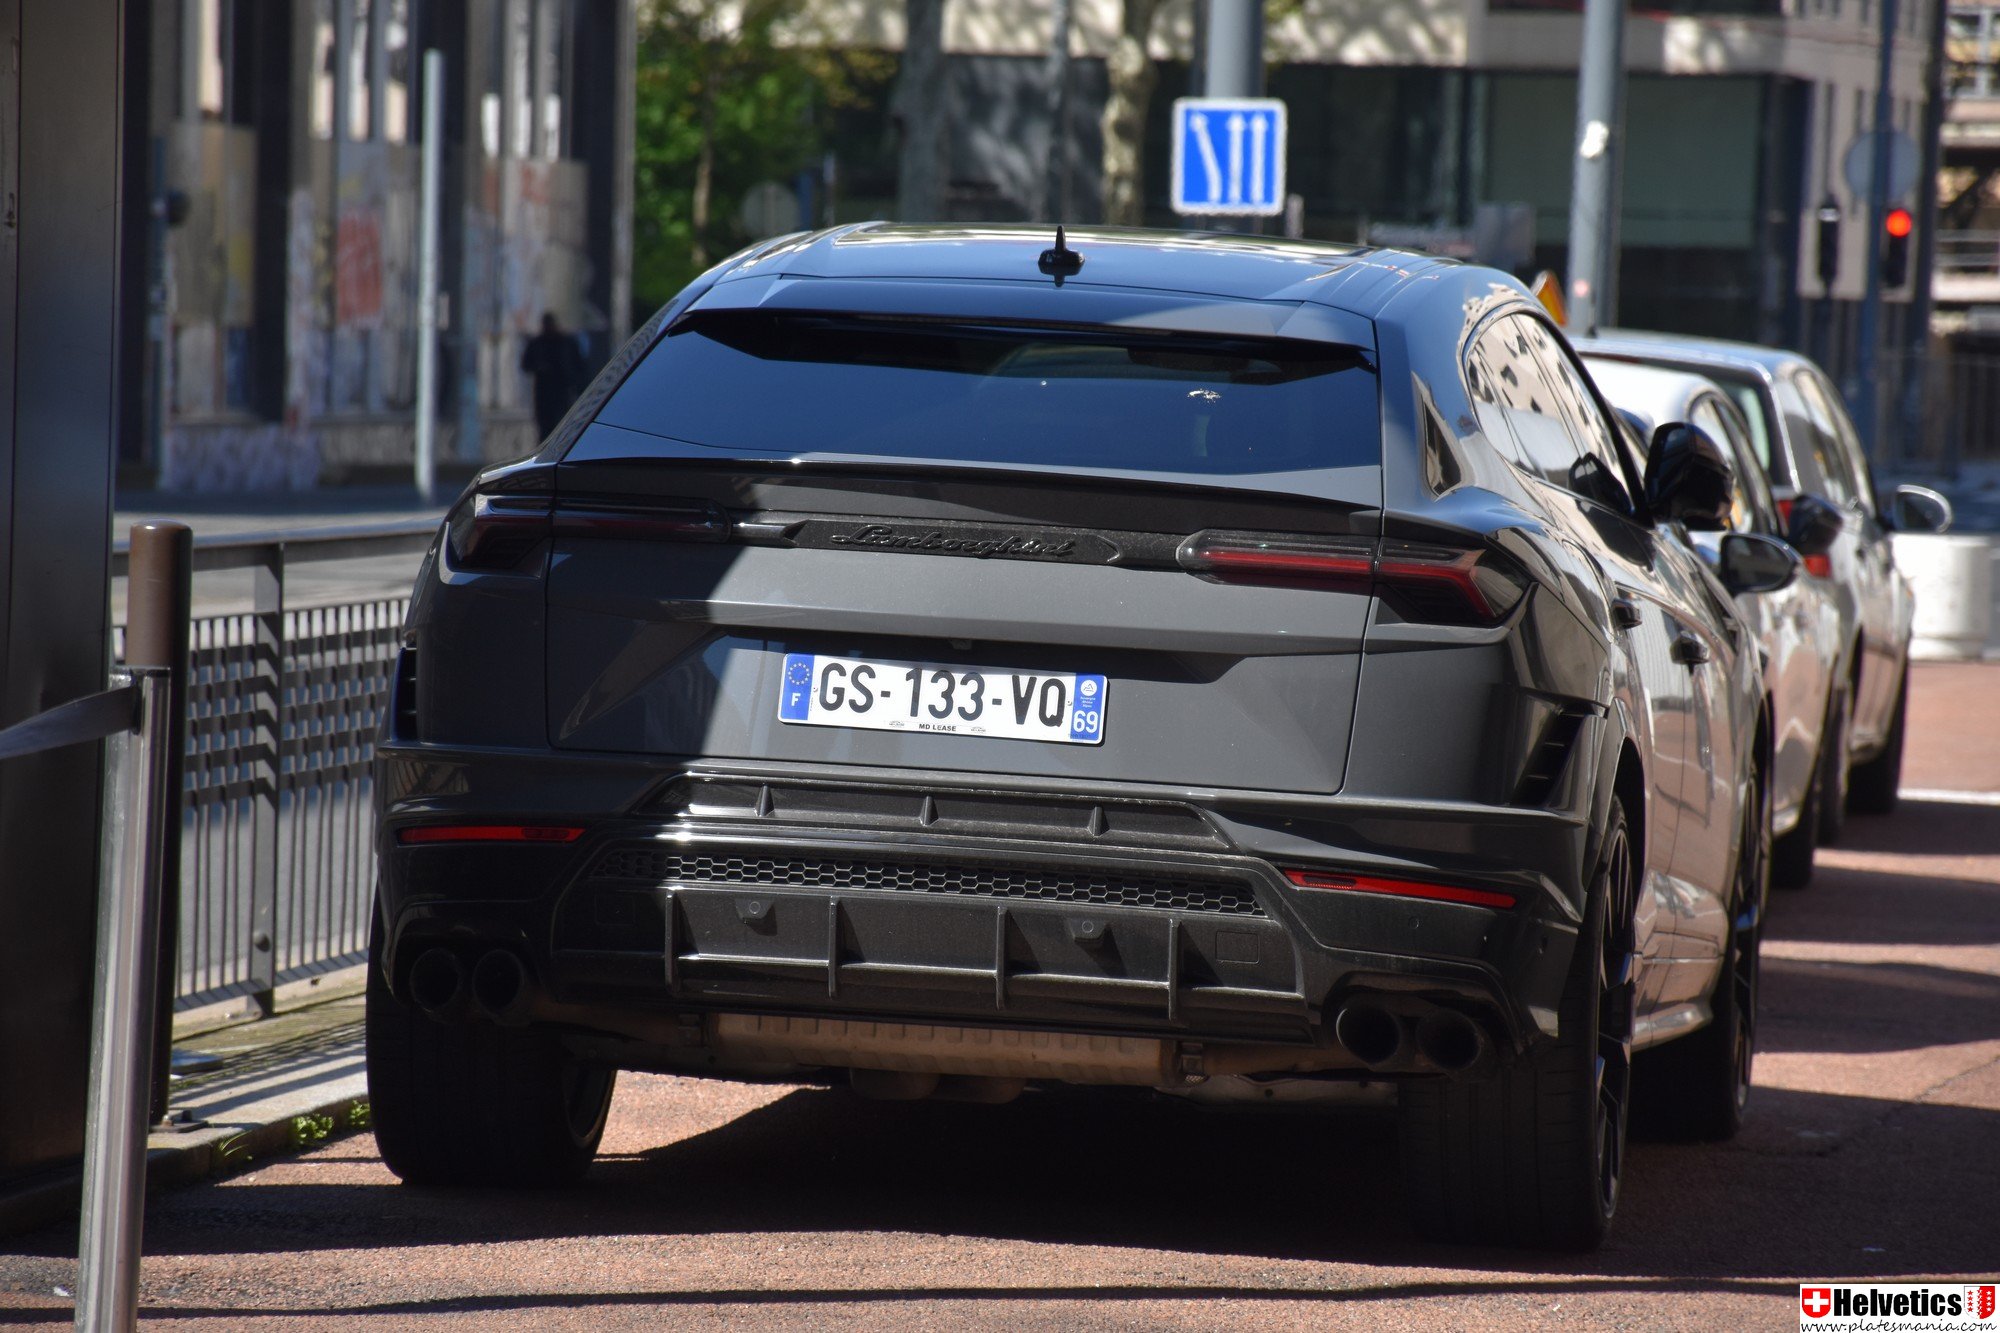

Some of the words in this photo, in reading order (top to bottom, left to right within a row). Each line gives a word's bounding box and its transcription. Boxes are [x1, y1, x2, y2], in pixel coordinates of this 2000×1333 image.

[830, 525, 1076, 559] Lamborghini
[791, 693, 801, 706] F
[819, 663, 1066, 727] GS-133-VQ
[932, 724, 957, 732] LEASE
[1073, 710, 1099, 734] 69
